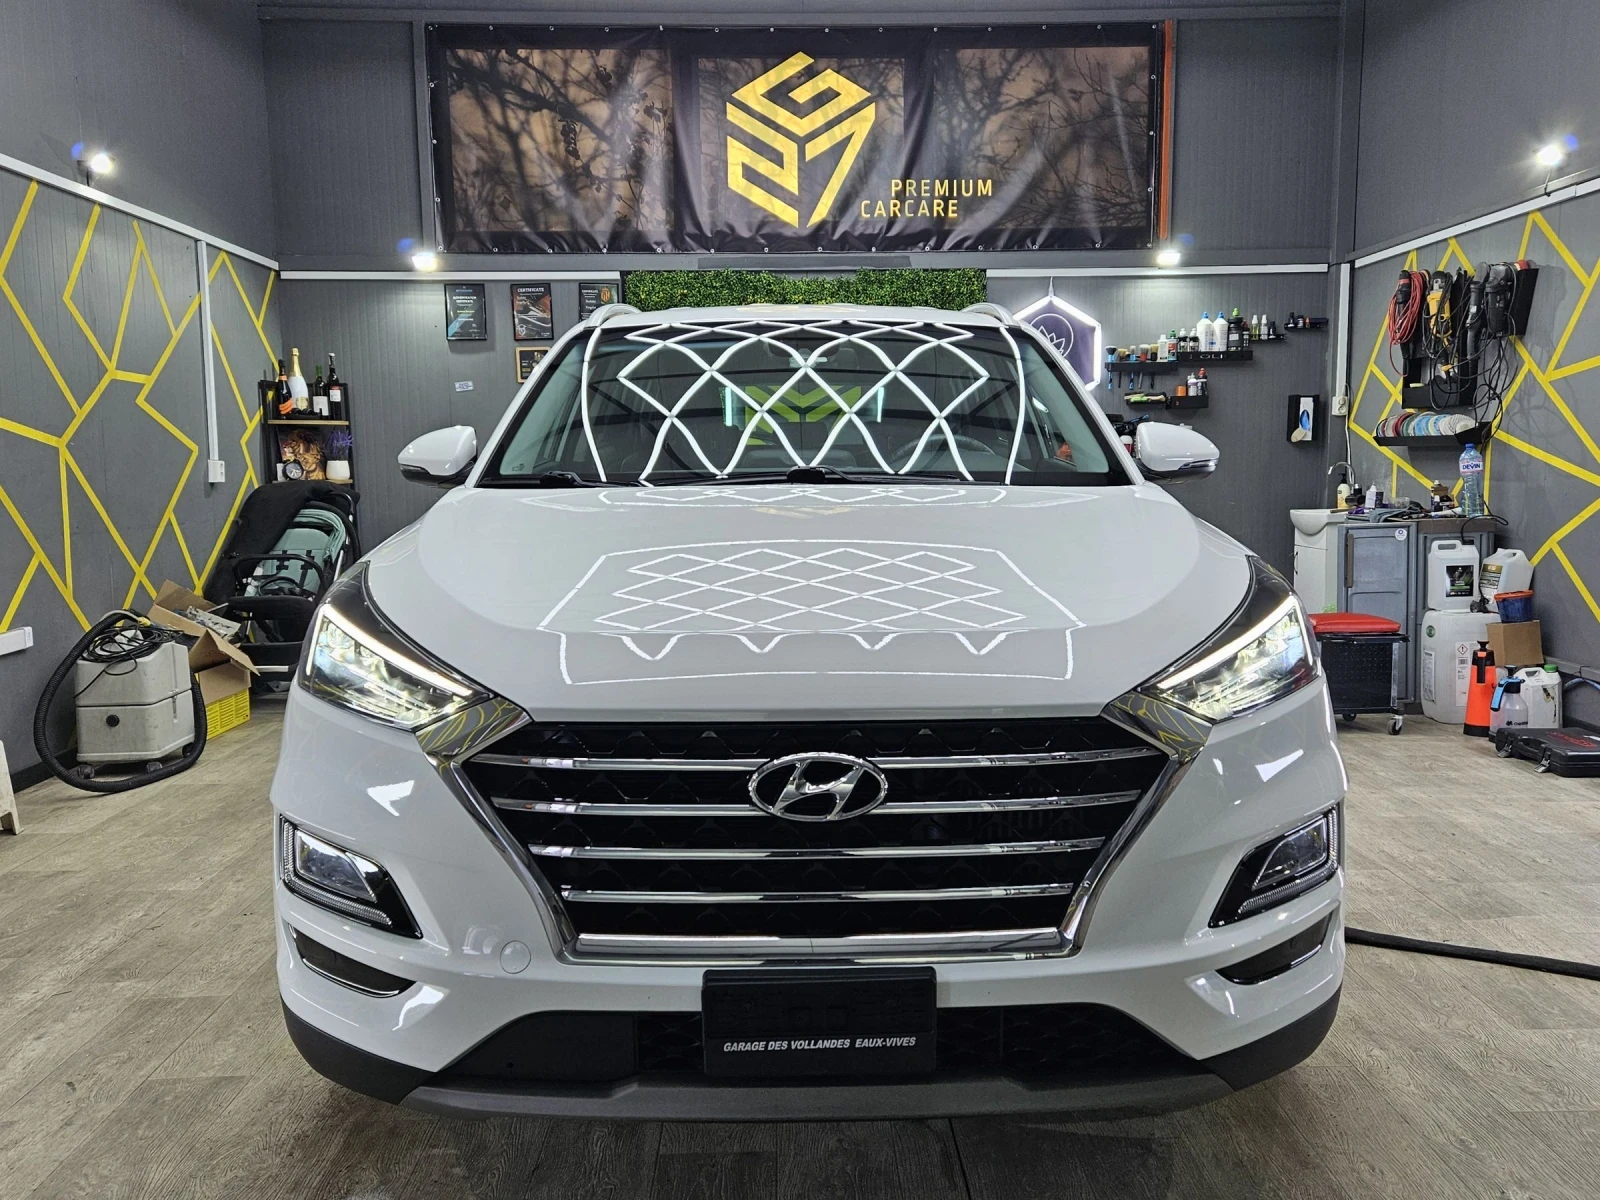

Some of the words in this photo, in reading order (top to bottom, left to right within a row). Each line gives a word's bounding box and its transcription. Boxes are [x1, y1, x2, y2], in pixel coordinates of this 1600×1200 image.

[891, 179, 993, 197] PREMIUM
[860, 199, 959, 218] CARCARE
[723, 1041, 766, 1052] GARAGE
[767, 1040, 788, 1051] DES
[790, 1039, 851, 1050] VOLLANDES
[855, 1036, 917, 1048] EAUX-VIVES
